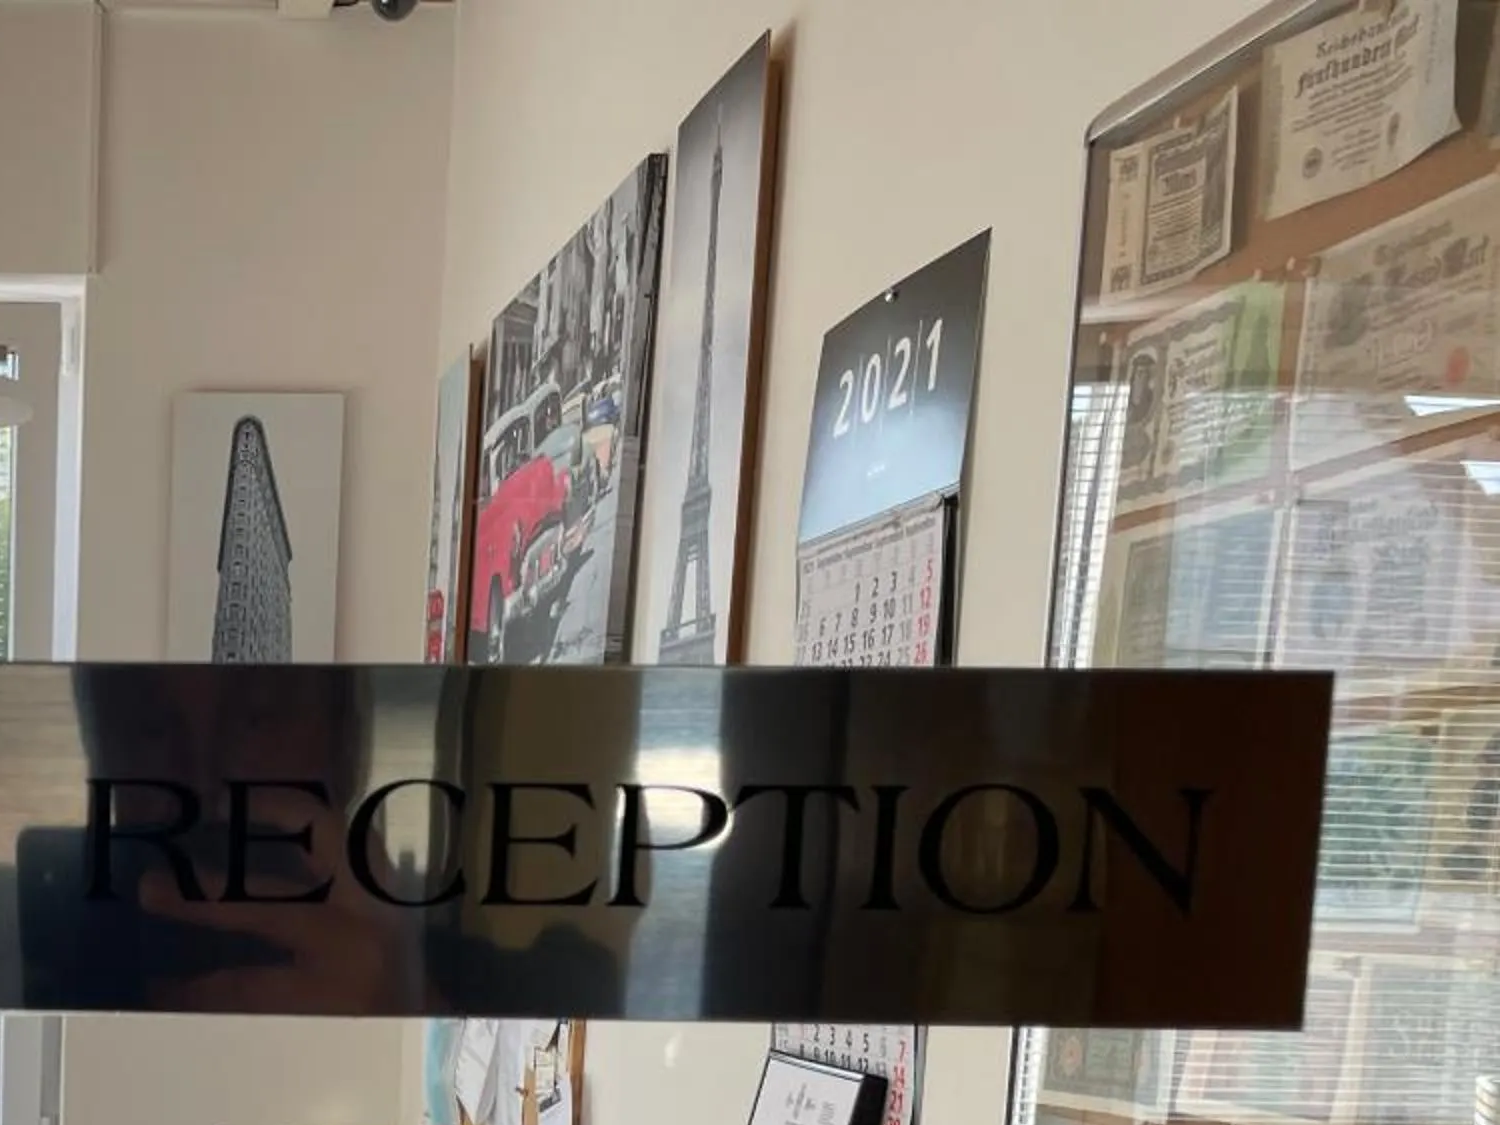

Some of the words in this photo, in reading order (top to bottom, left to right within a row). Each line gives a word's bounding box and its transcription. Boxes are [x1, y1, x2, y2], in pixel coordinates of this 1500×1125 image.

[833, 317, 943, 439] 2021
[871, 576, 879, 598] 2
[890, 571, 897, 592] 3
[924, 559, 933, 582] 5
[851, 607, 859, 628] 8
[869, 602, 877, 624] 9
[883, 597, 896, 619] 10
[919, 586, 931, 610] 12
[844, 632, 856, 654] 15
[863, 627, 876, 650] 16
[882, 622, 895, 645] 17
[86, 777, 1215, 919] RECEPTION
[829, 1026, 836, 1045] 3
[863, 1033, 869, 1052] 5
[890, 1090, 904, 1113] 21
